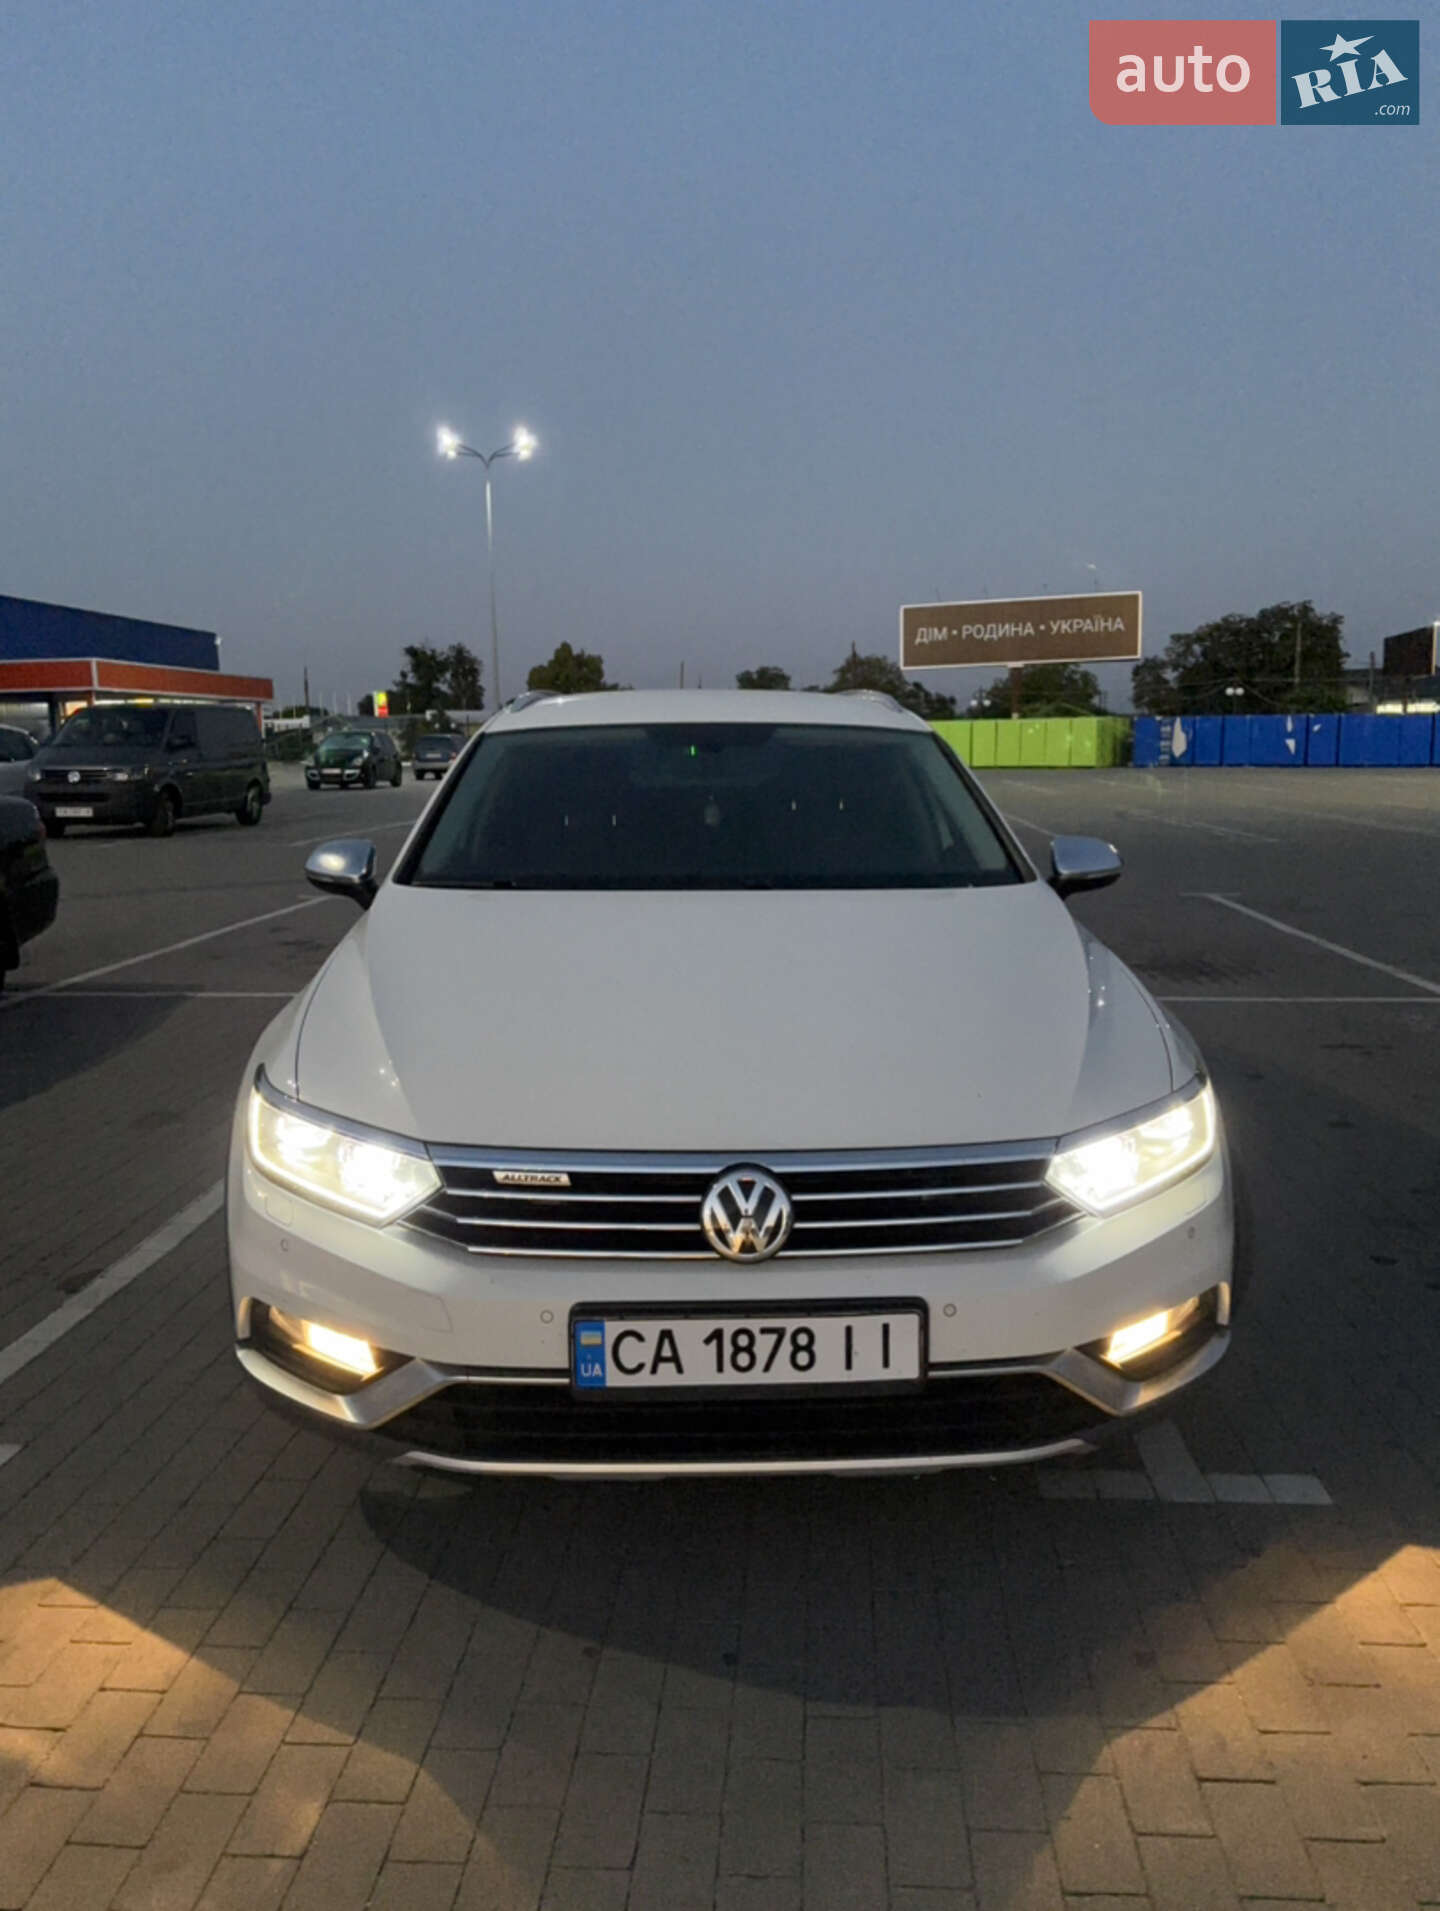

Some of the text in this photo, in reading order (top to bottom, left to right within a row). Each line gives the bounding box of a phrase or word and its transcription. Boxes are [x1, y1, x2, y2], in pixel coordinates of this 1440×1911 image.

[914, 614, 1126, 646] ДІМ РОДИНА УКРАЇНА
[501, 1172, 563, 1184] ALLTRACK
[611, 1328, 685, 1375] CA
[702, 1325, 817, 1374] 1878
[580, 1362, 603, 1378] UA
